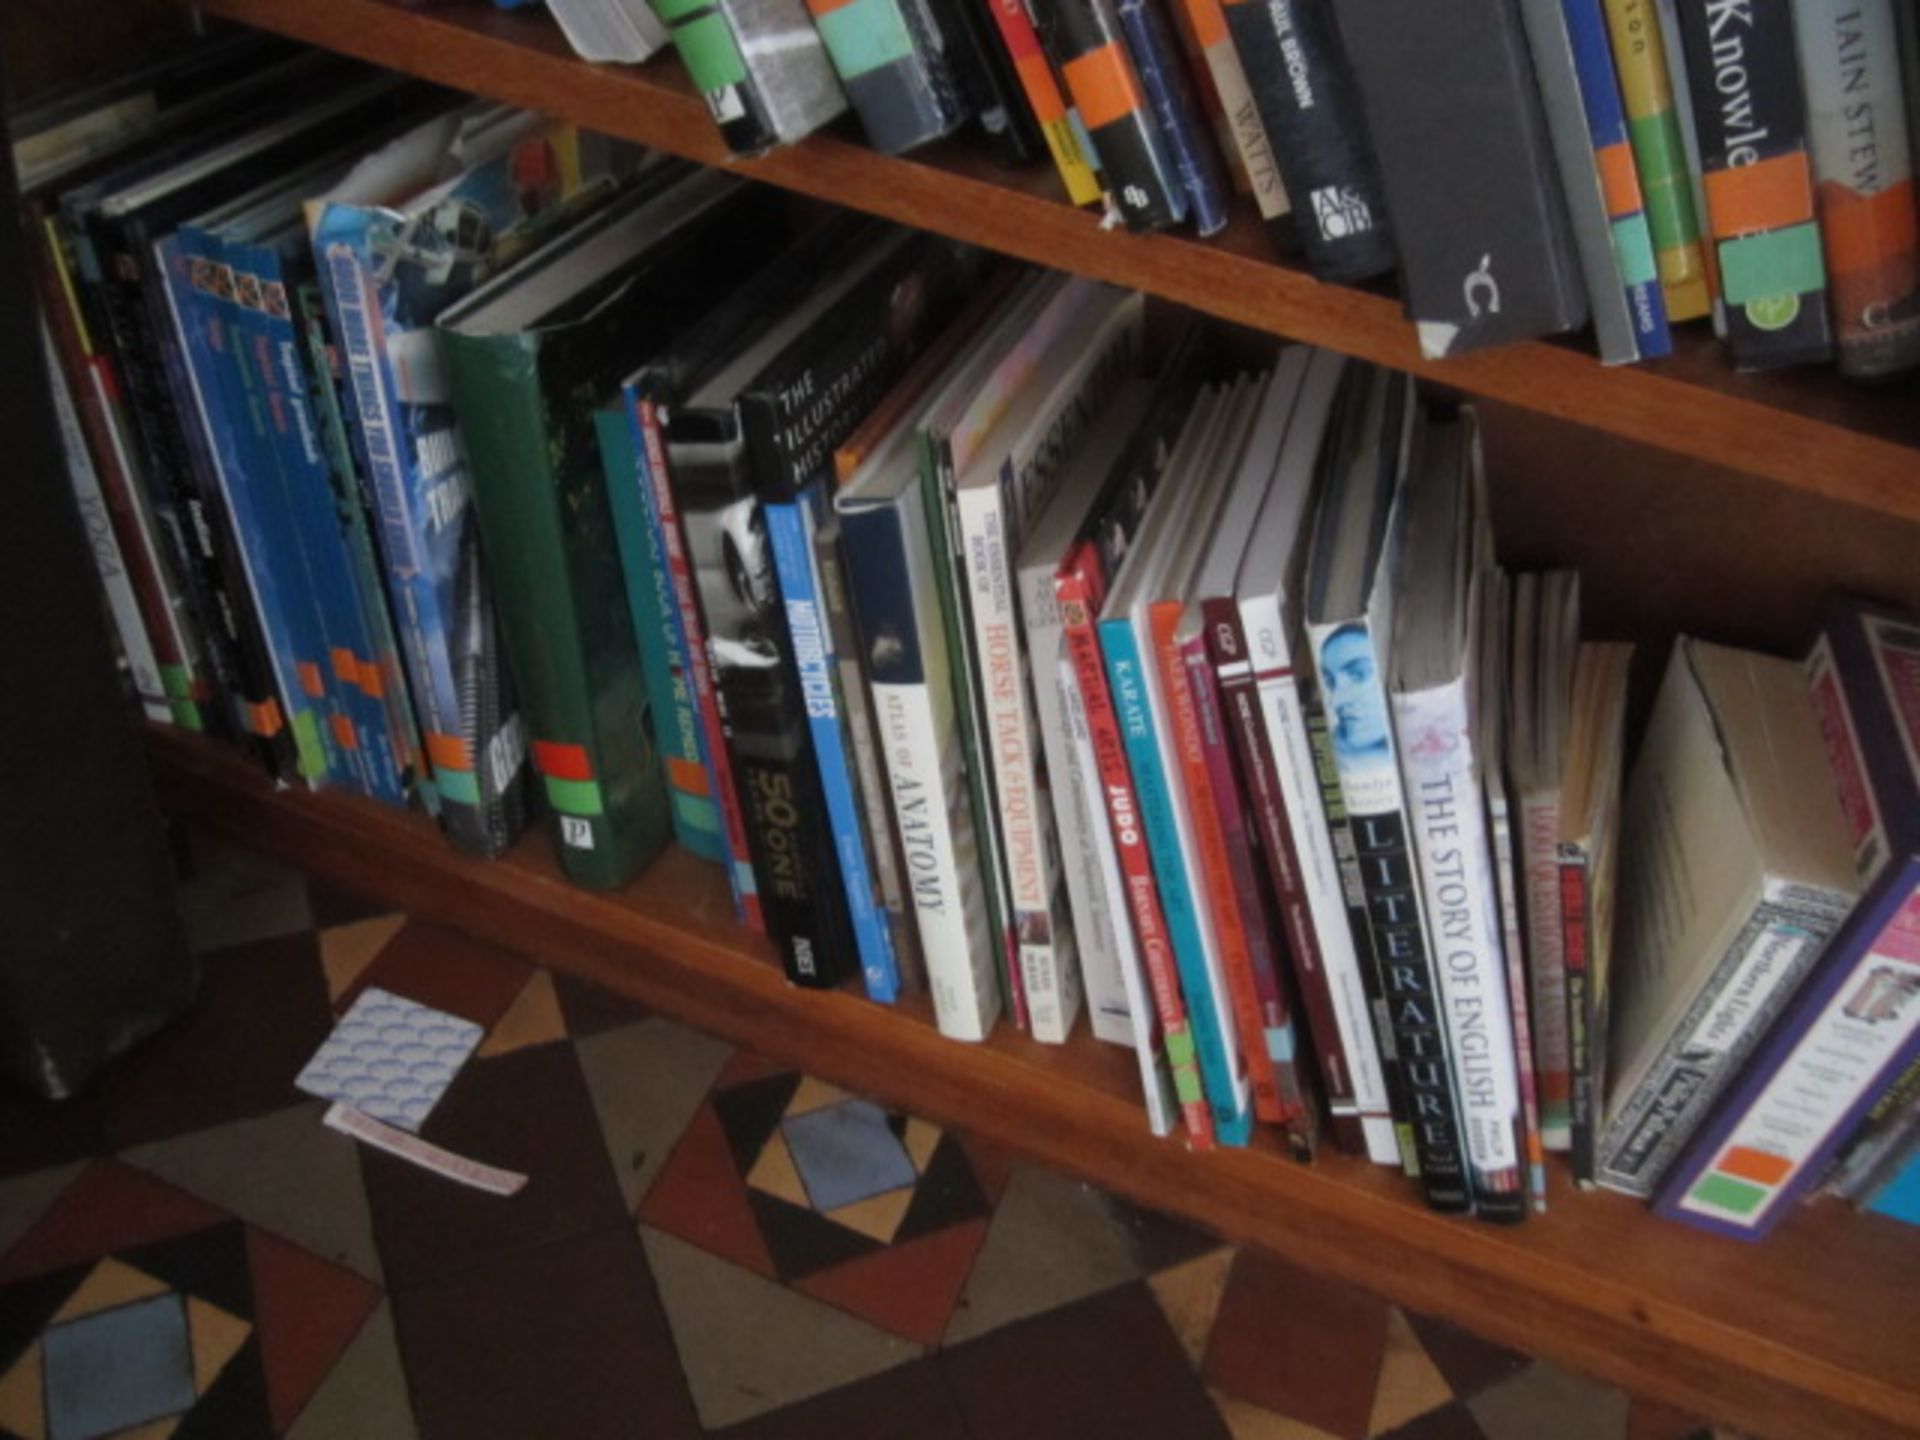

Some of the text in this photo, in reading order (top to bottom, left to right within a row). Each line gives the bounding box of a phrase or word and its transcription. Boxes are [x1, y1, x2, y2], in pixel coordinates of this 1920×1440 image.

[1279, 37, 1313, 108] BROWN
[1835, 11, 1869, 94] IAIN
[1236, 100, 1277, 194] WATTS
[353, 358, 385, 423] THINGS
[777, 367, 813, 417] THE
[368, 424, 391, 457] YOU
[89, 497, 120, 579] YOGA
[971, 535, 990, 595] BOOK OF
[983, 510, 1009, 614] THE ESSENTIAL
[789, 596, 831, 720] MOTORCYCLES
[985, 622, 1017, 701] HORSE
[1216, 622, 1238, 655] CGP
[997, 707, 1023, 768] TACK
[1114, 658, 1145, 739] KARATE
[757, 770, 795, 827] 50
[885, 692, 946, 917] ATLAS OF ANATOMY
[1110, 782, 1137, 848] JUDO
[767, 828, 798, 902] ONE
[1014, 783, 1041, 903] EQUIPMENT
[1420, 773, 1494, 1109] THE STORY OF ENGLISH
[1531, 861, 1561, 968] QUESTIONS
[1364, 818, 1456, 1148] LITERATURE
[1702, 930, 1792, 1049] Northern Lights
